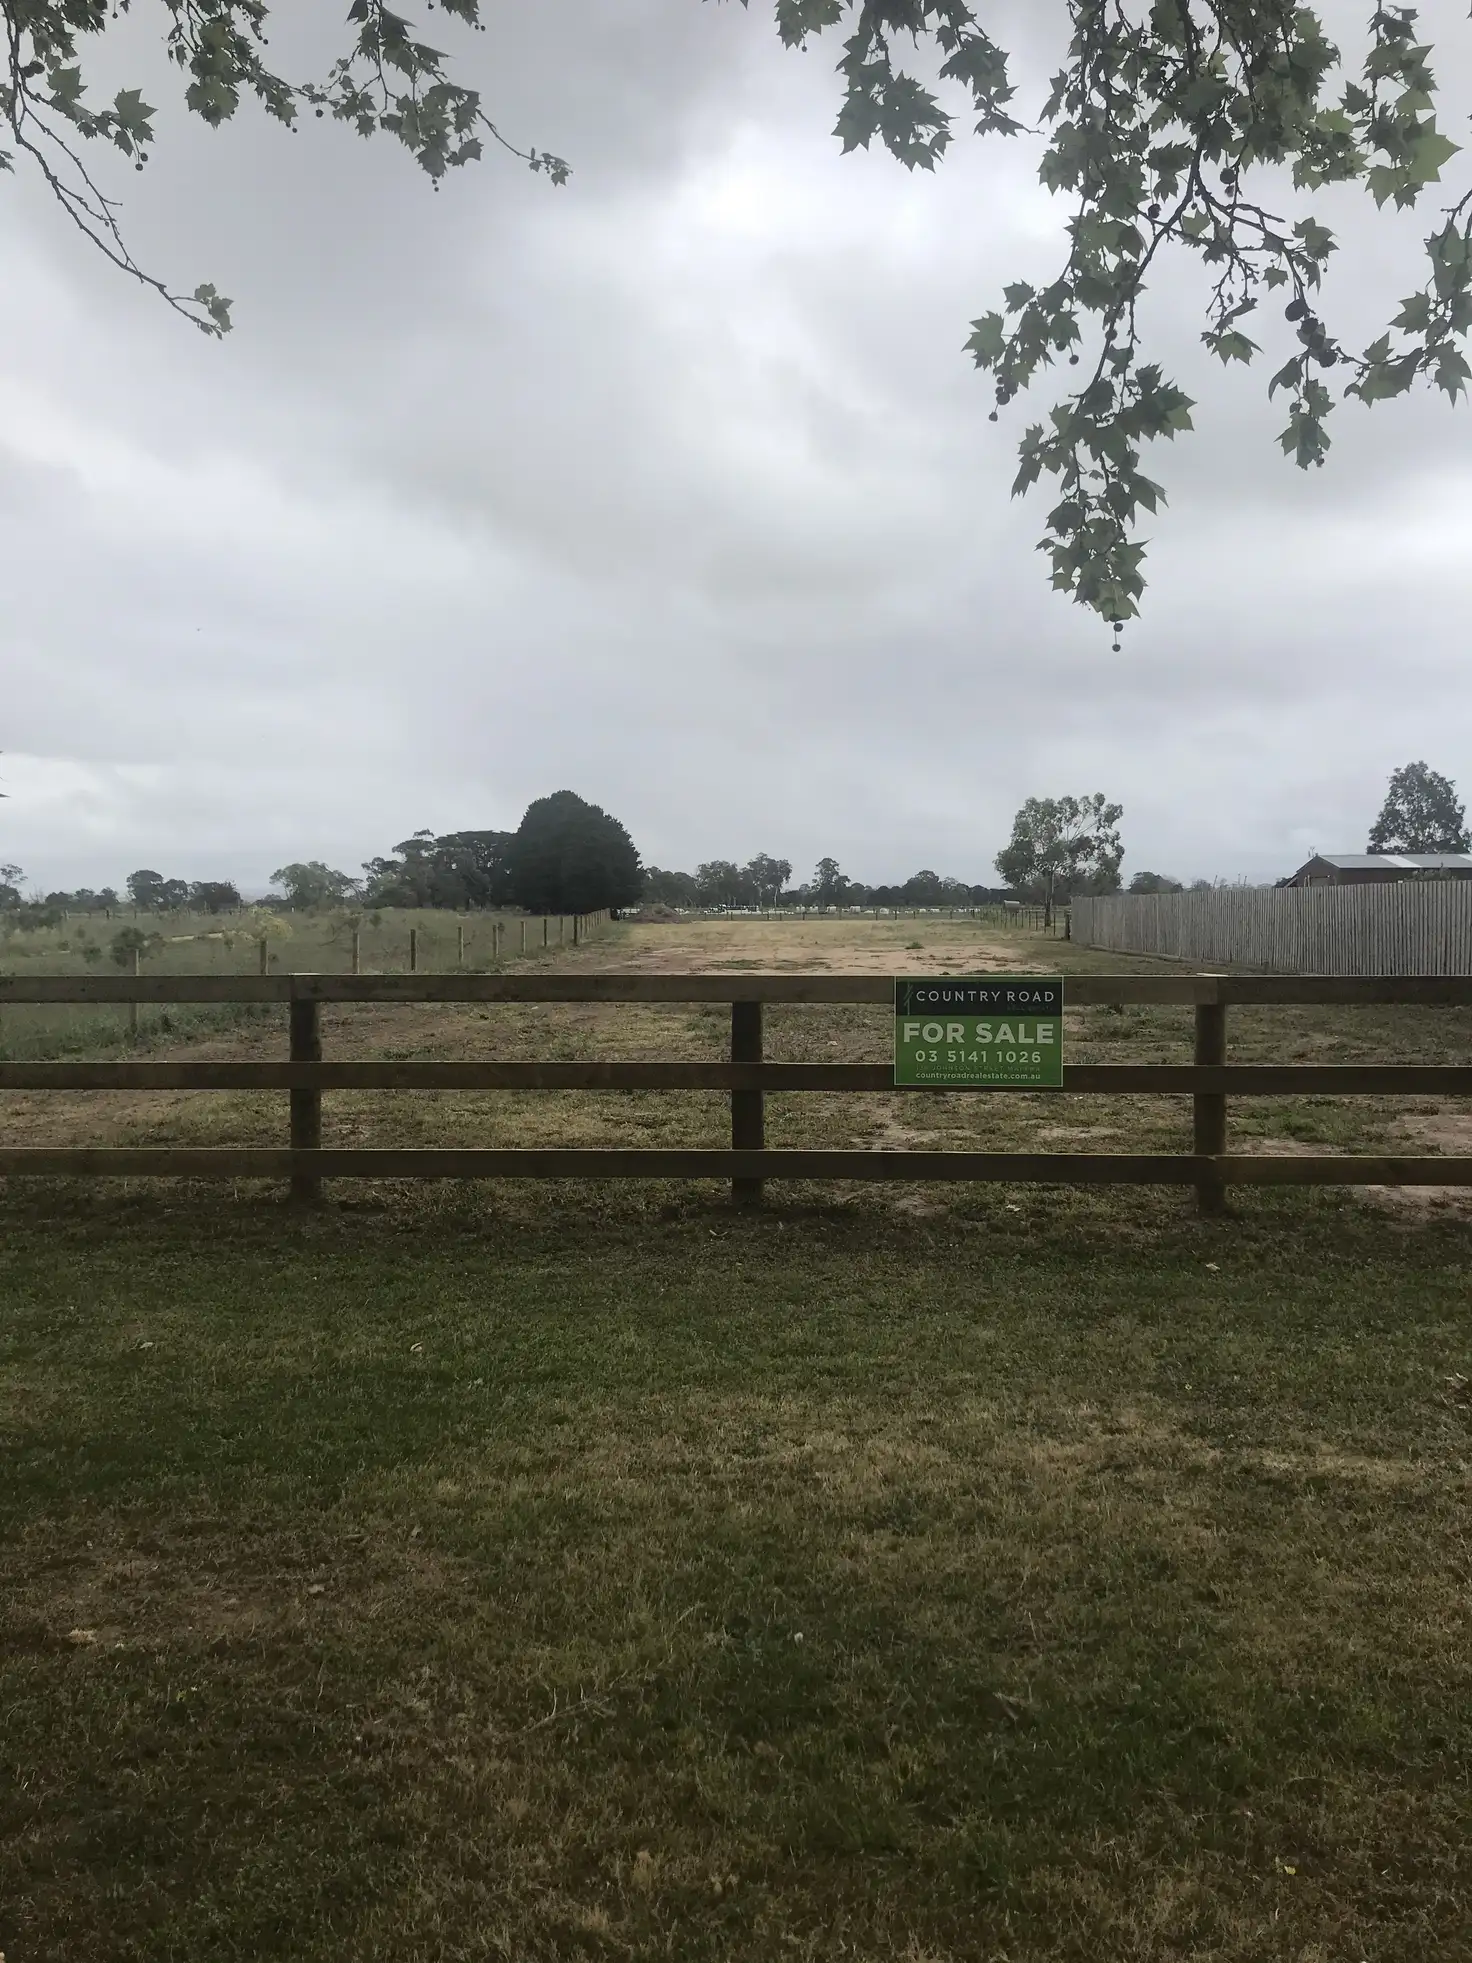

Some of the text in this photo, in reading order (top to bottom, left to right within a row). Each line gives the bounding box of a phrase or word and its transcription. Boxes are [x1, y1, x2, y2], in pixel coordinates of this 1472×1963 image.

[916, 991, 1054, 1002] COUNTRY ROAD
[903, 1022, 1054, 1044] FOR SALE
[915, 1050, 1041, 1063] 03 5141 1026
[915, 1072, 1041, 1081] countryroadrealestate.com.au
